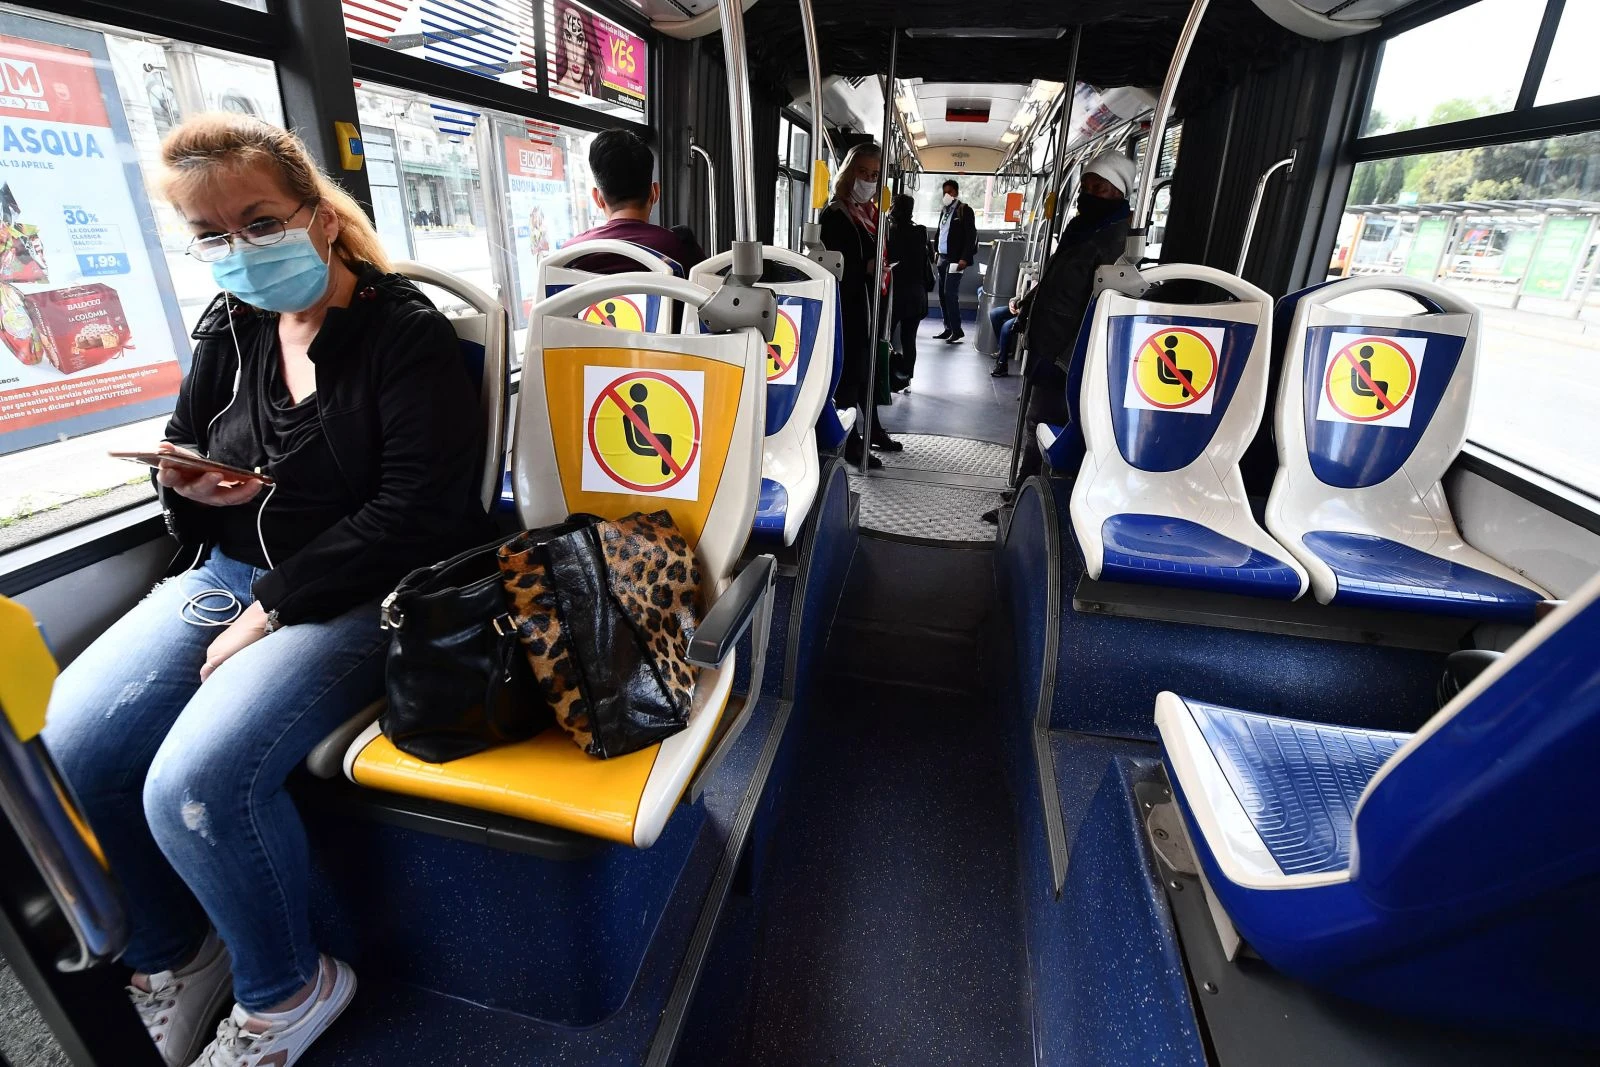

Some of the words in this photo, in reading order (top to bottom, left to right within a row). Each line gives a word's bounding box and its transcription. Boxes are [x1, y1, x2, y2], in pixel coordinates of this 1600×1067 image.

[566, 14, 582, 33] YES
[609, 36, 635, 73] YES
[10, 160, 20, 168] 13
[21, 161, 54, 170] APRILE
[520, 150, 552, 170] EKOM
[63, 209, 99, 225] 30%
[66, 298, 101, 311] BALOCCO
[75, 309, 108, 321] COLOMBA
[39, 385, 61, 395] nostri
[60, 380, 97, 391] dipendenti
[1, 404, 15, 413] per
[15, 396, 50, 410] garantire
[55, 390, 83, 400] servizio
[93, 384, 113, 394] nostri
[48, 400, 76, 411] diciamo
